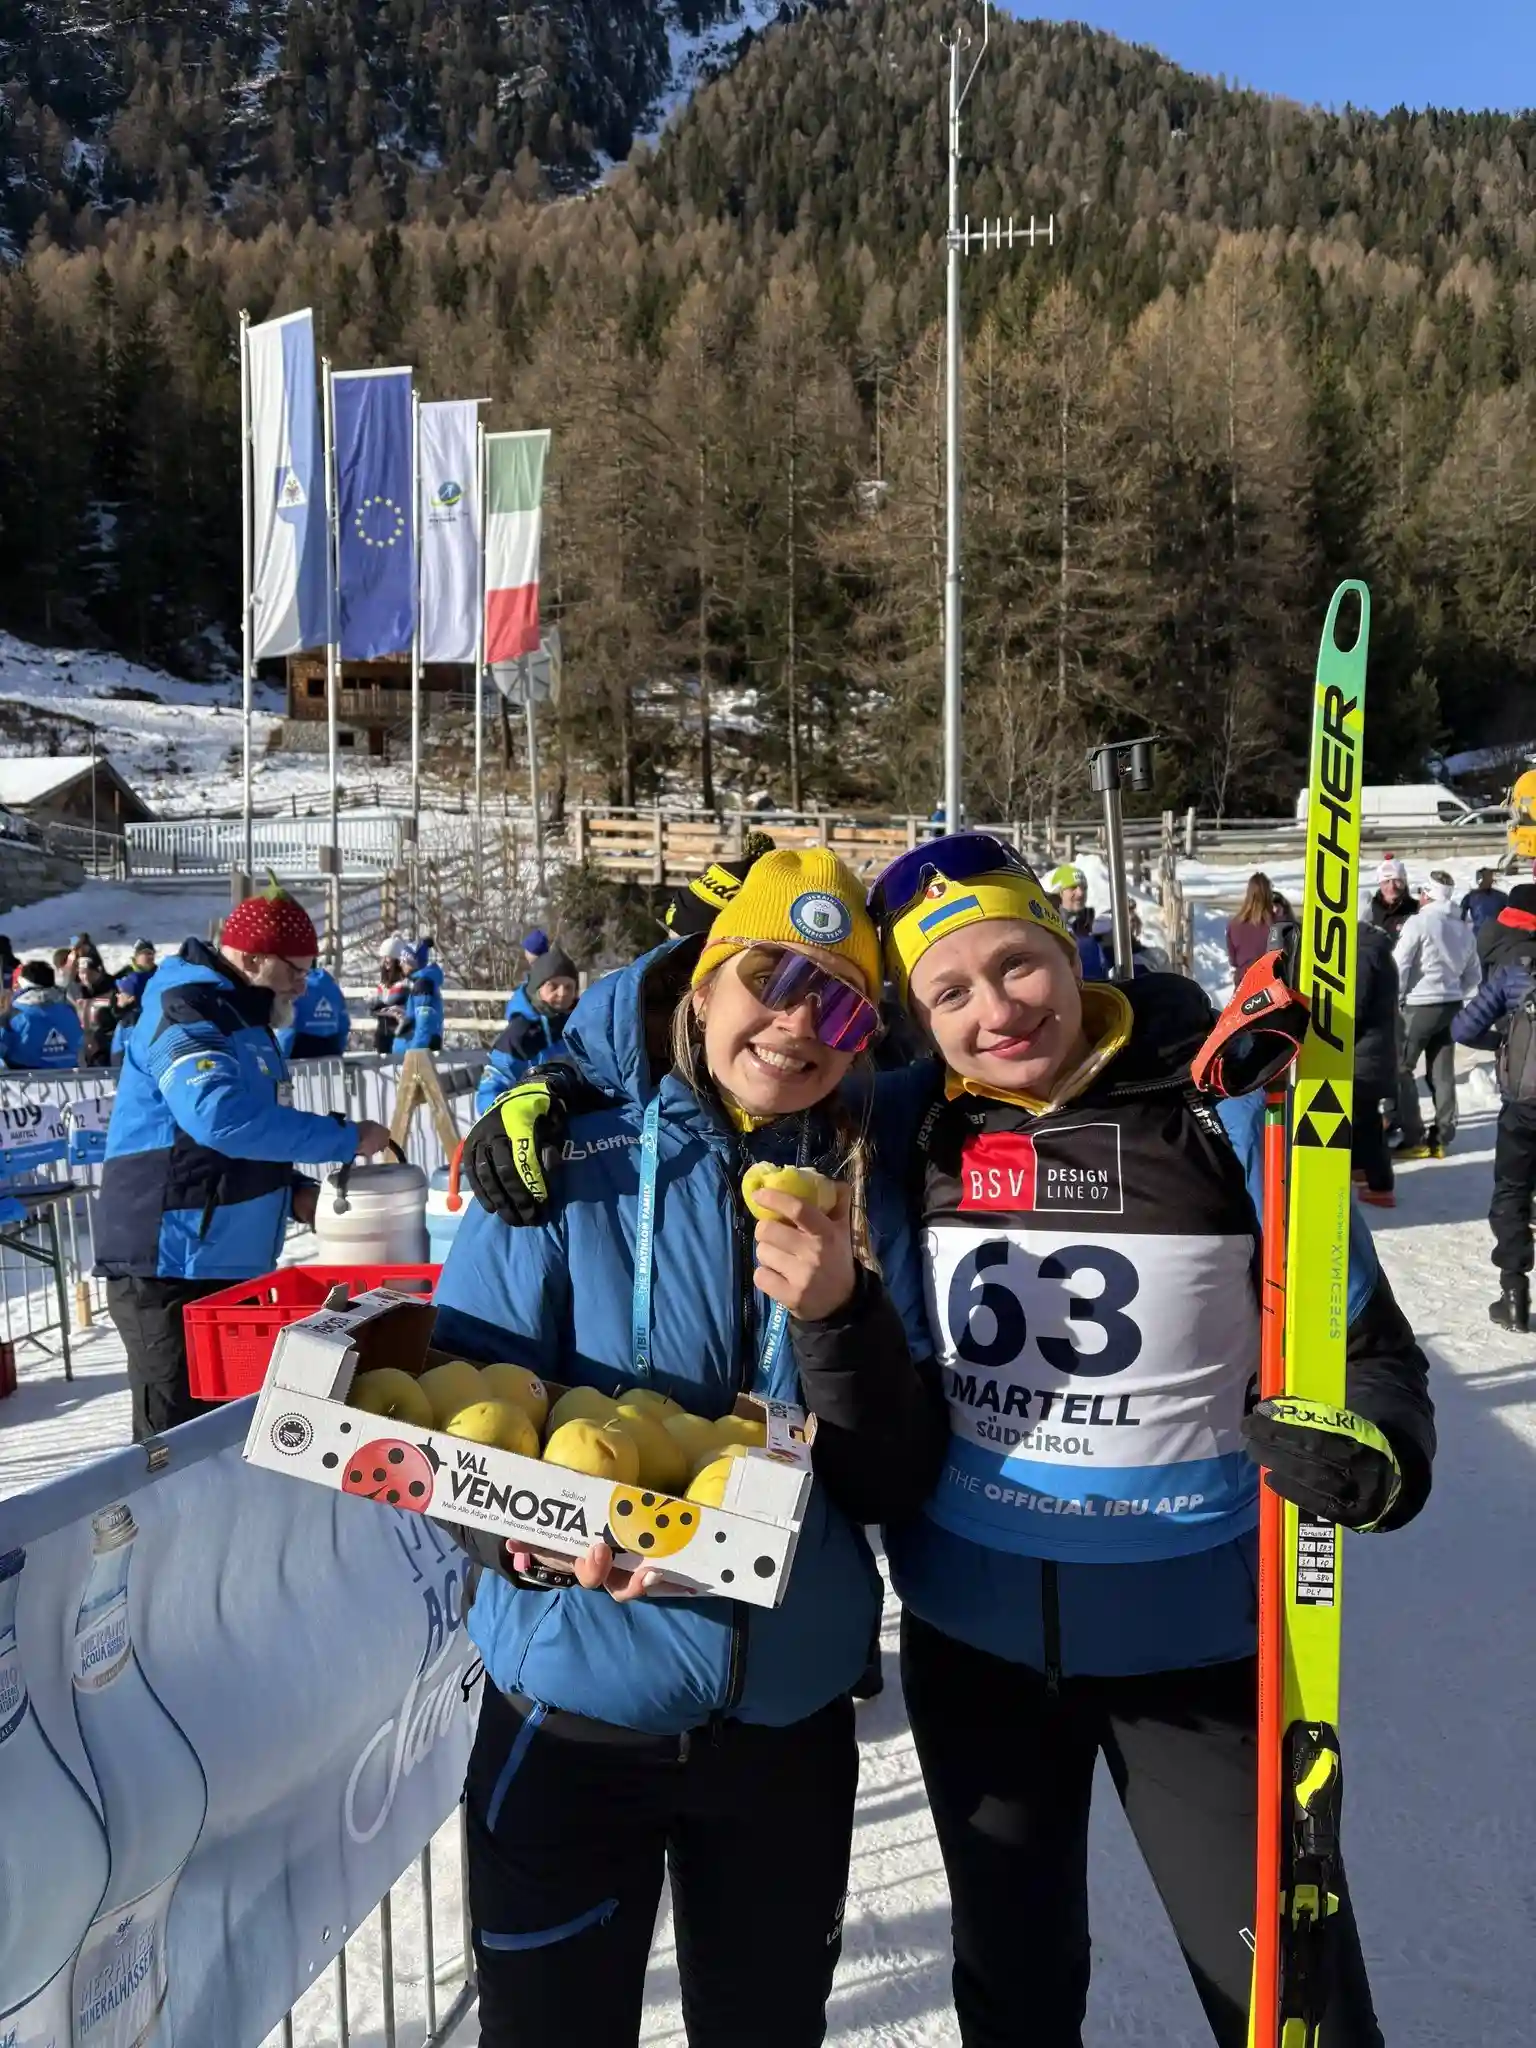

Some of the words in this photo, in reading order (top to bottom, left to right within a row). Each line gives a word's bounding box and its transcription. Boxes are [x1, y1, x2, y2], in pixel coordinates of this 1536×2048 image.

[1311, 684, 1358, 1053] FISCHER
[2, 1105, 43, 1130] 109
[641, 1184, 651, 1218] FAMILY
[969, 1168, 1025, 1201] BSV
[1047, 1167, 1109, 1184] DESIGN
[1047, 1184, 1087, 1199] LINE
[1090, 1185, 1109, 1200] 07
[947, 1239, 1143, 1378] 63
[950, 1374, 1141, 1427] MARTELL
[456, 1449, 488, 1476] VAL
[451, 1470, 589, 1538] VENOSTA
[948, 1465, 980, 1494] THE
[982, 1483, 1098, 1518] OFFICIAL
[1103, 1498, 1150, 1518] IBU
[1153, 1494, 1205, 1516] APP
